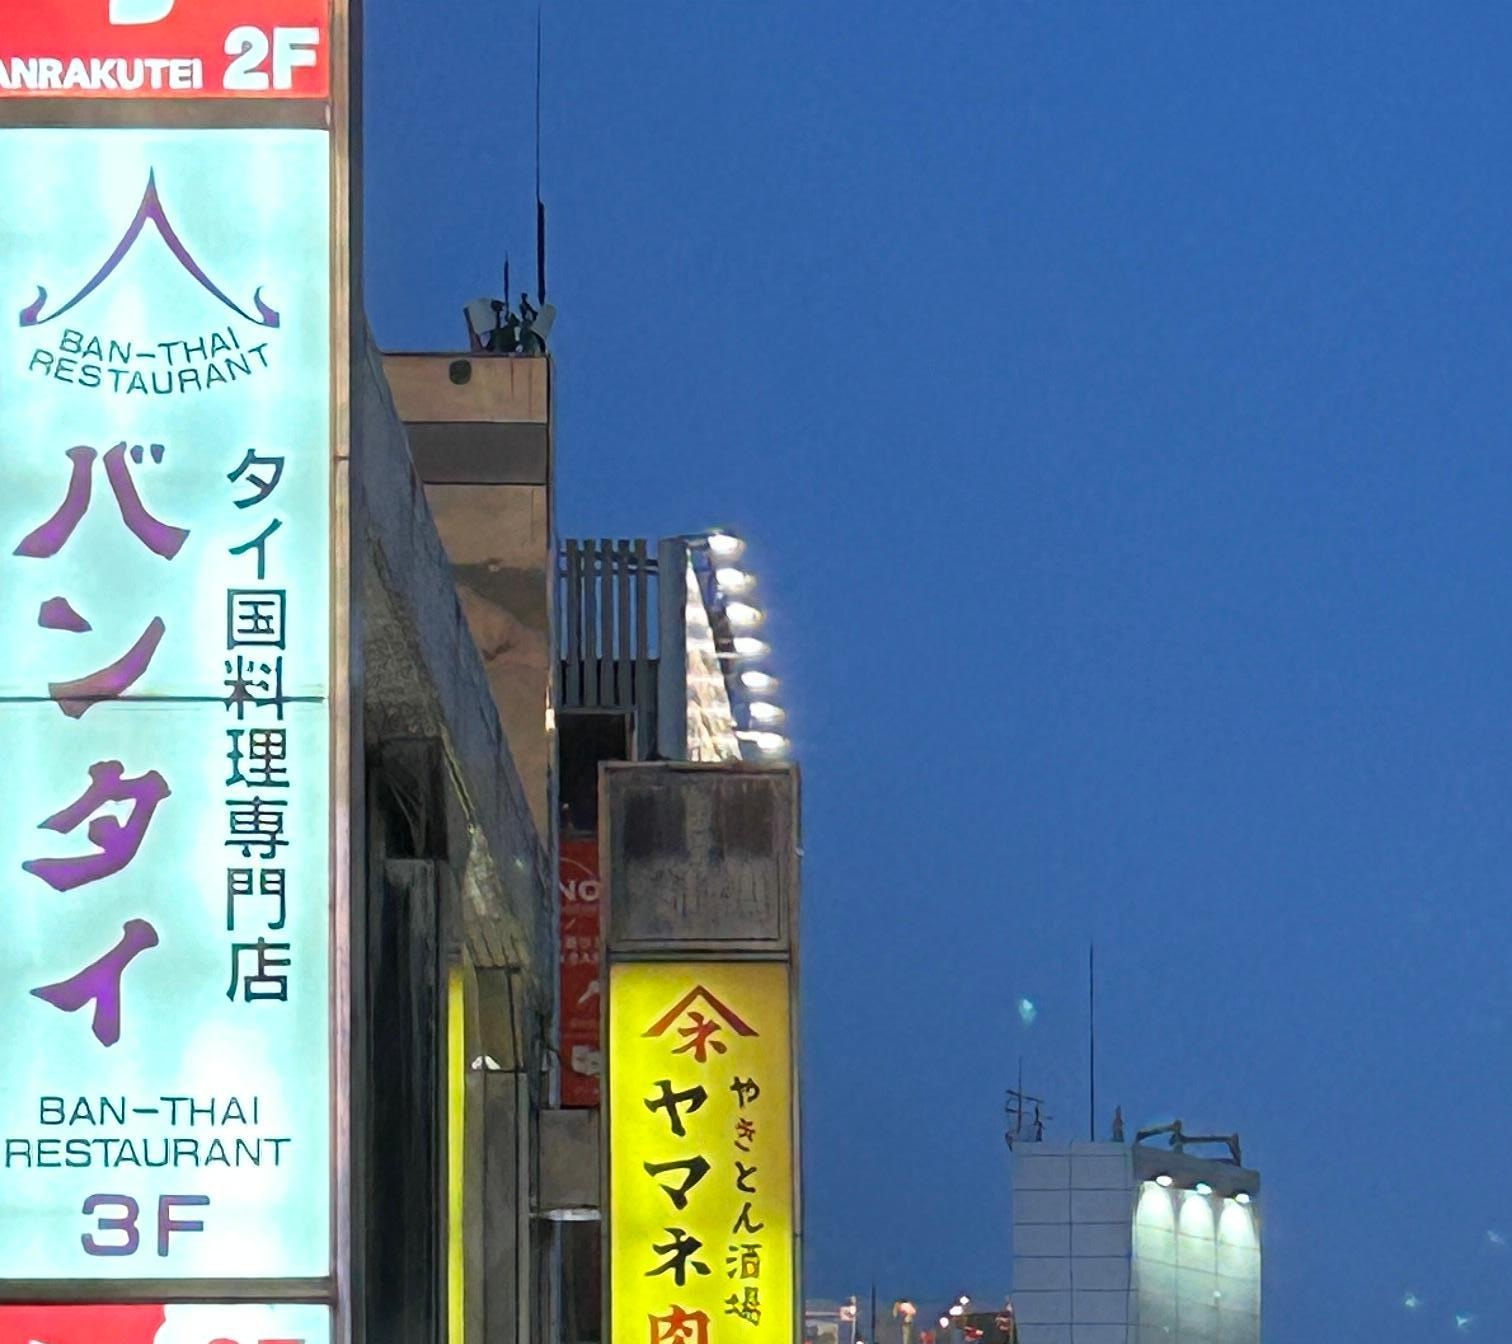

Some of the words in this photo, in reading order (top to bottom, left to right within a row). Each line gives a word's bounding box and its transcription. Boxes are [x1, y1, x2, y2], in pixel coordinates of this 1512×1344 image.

[223, 26, 319, 90] 2F
[29, 342, 271, 395] RESTAURANT
[58, 325, 241, 366] BAN-THAI
[14, 441, 190, 1047] バンタイ
[223, 449, 291, 1003] タイ国料理専門店
[38, 1095, 261, 1127] BAN-THAI
[5, 1137, 291, 1168] RESTAURANT
[81, 1195, 210, 1257] 3F
[724, 1076, 763, 1328] やきとん酒場
